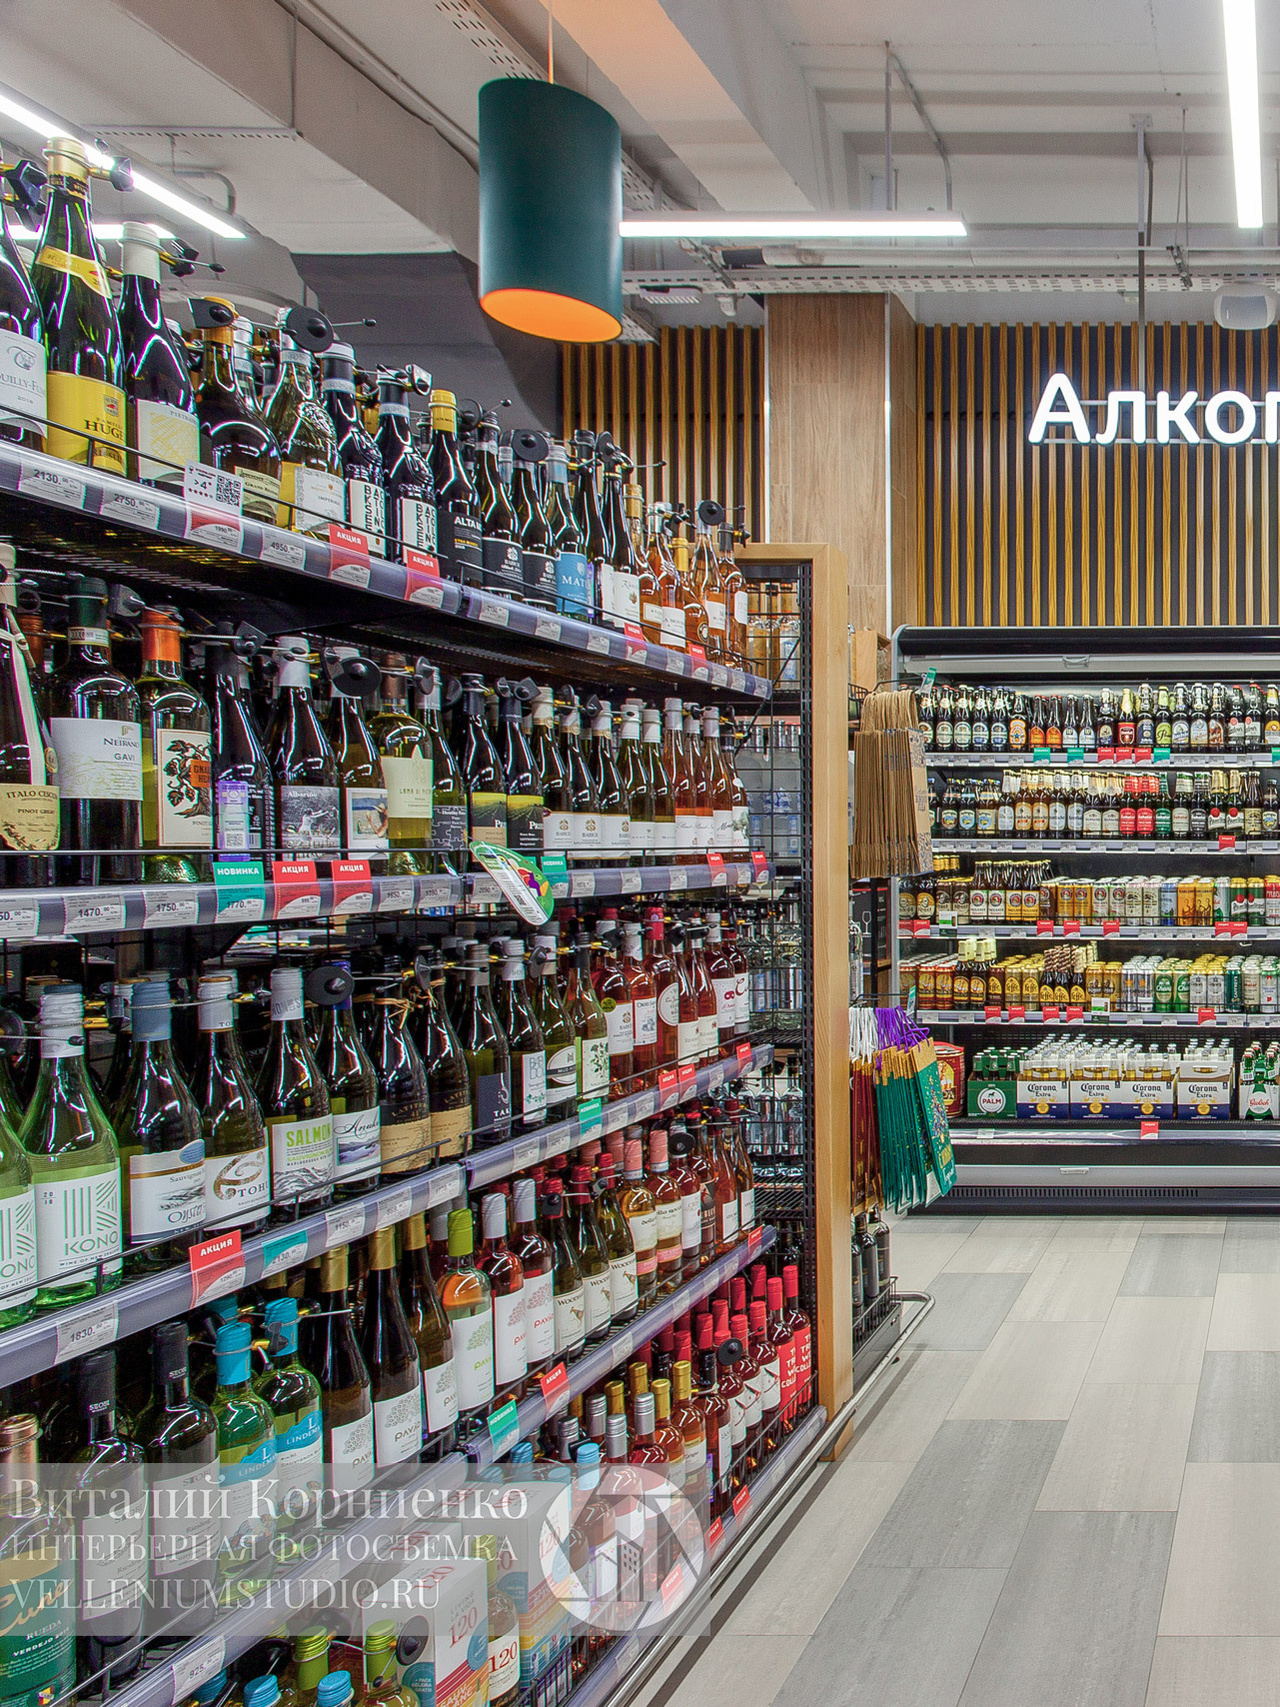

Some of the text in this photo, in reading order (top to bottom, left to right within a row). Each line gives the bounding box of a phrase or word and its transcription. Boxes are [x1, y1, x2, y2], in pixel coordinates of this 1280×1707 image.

[337, 531, 362, 545] АКЦИЯ
[412, 555, 434, 568] АКЦИЯ
[114, 753, 135, 762] GAVI
[7, 790, 36, 799] ITALO
[217, 867, 259, 876] НОВИНКА
[281, 866, 309, 874] АКЦИЯ
[339, 864, 363, 872] АКЦИЯ
[1027, 1082, 1057, 1093] Corona
[1080, 1082, 1110, 1092] Corona
[1132, 1083, 1162, 1093] Corona
[1188, 1084, 1218, 1094] Corona
[982, 1097, 1001, 1105] PALM
[65, 1231, 119, 1255] KONO
[200, 1238, 233, 1256] АКЦИЯ
[449, 1607, 477, 1648] 120
[13, 1637, 53, 1656] VERDEJO
[488, 1641, 518, 1673] 120
